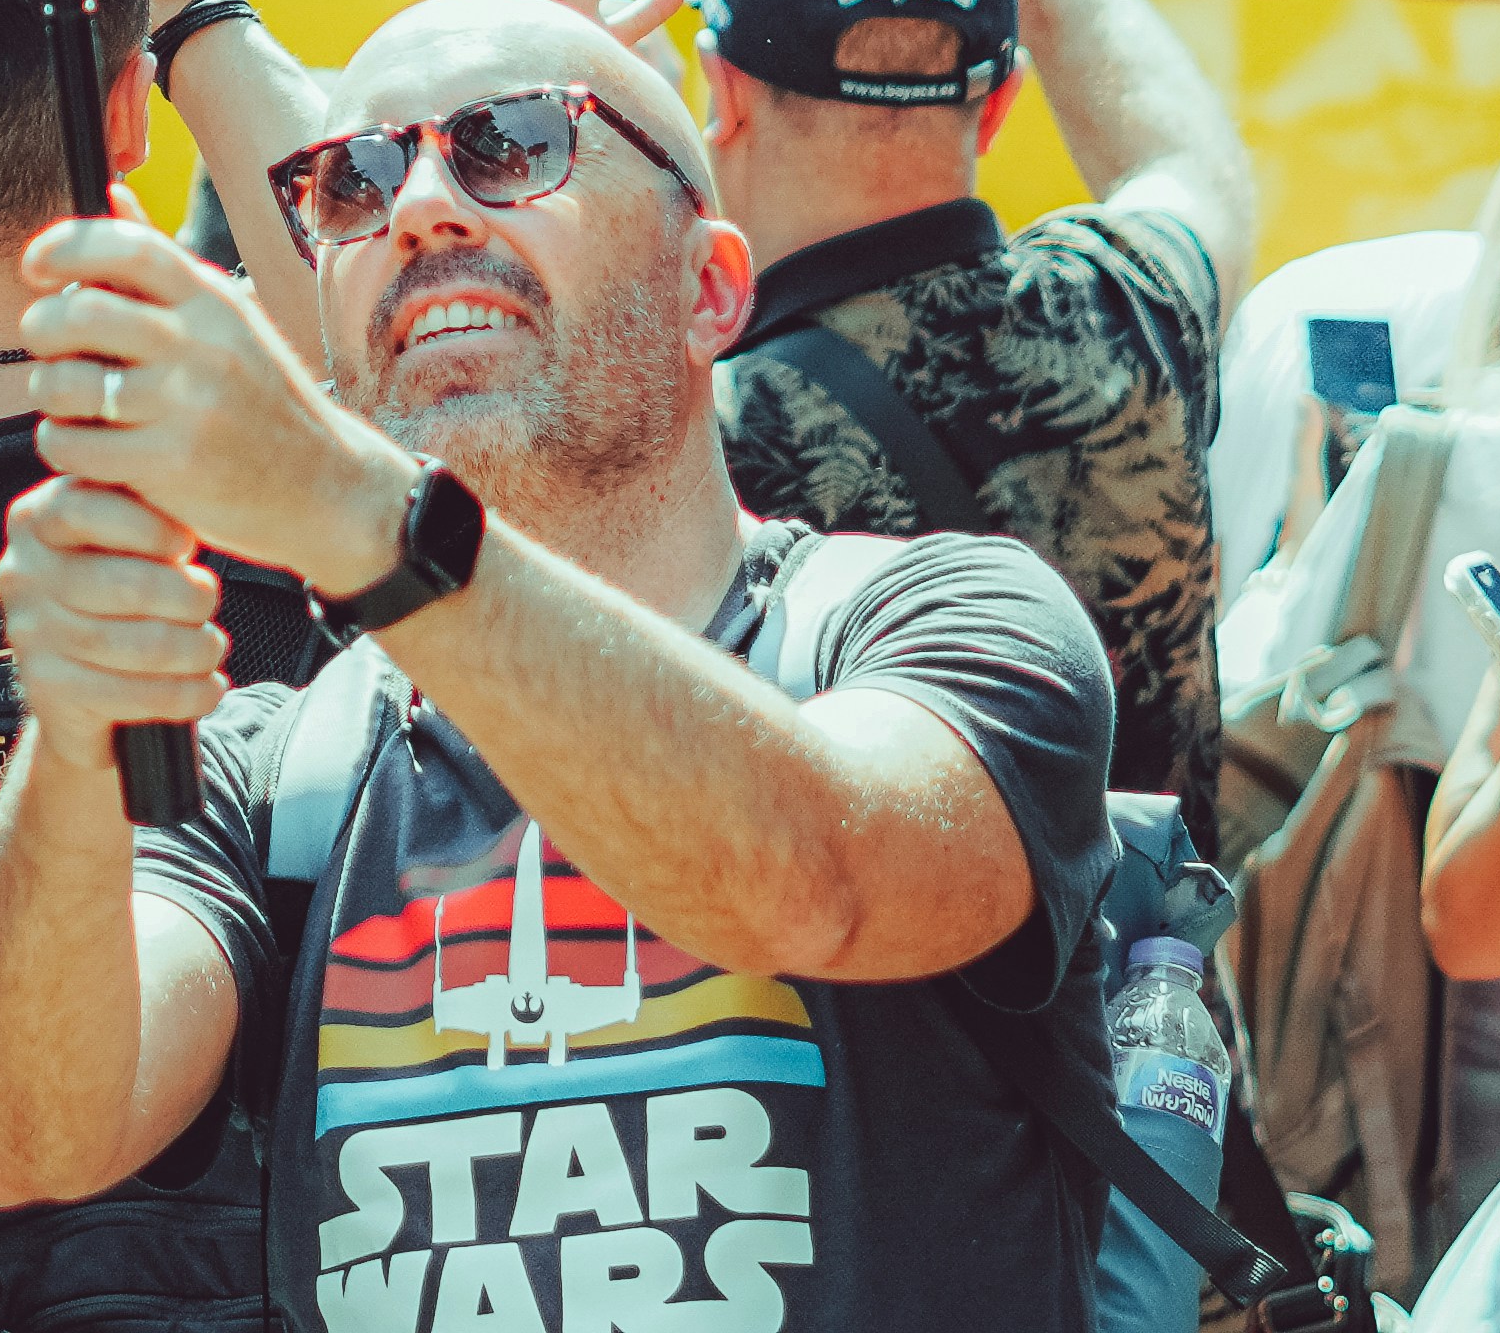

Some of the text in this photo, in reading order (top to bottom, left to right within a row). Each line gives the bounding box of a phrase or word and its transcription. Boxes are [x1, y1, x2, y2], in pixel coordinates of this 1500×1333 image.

[1156, 1067, 1213, 1102] Nestlé
[319, 1087, 812, 1274] STAR
[316, 1218, 814, 1333] WARS
